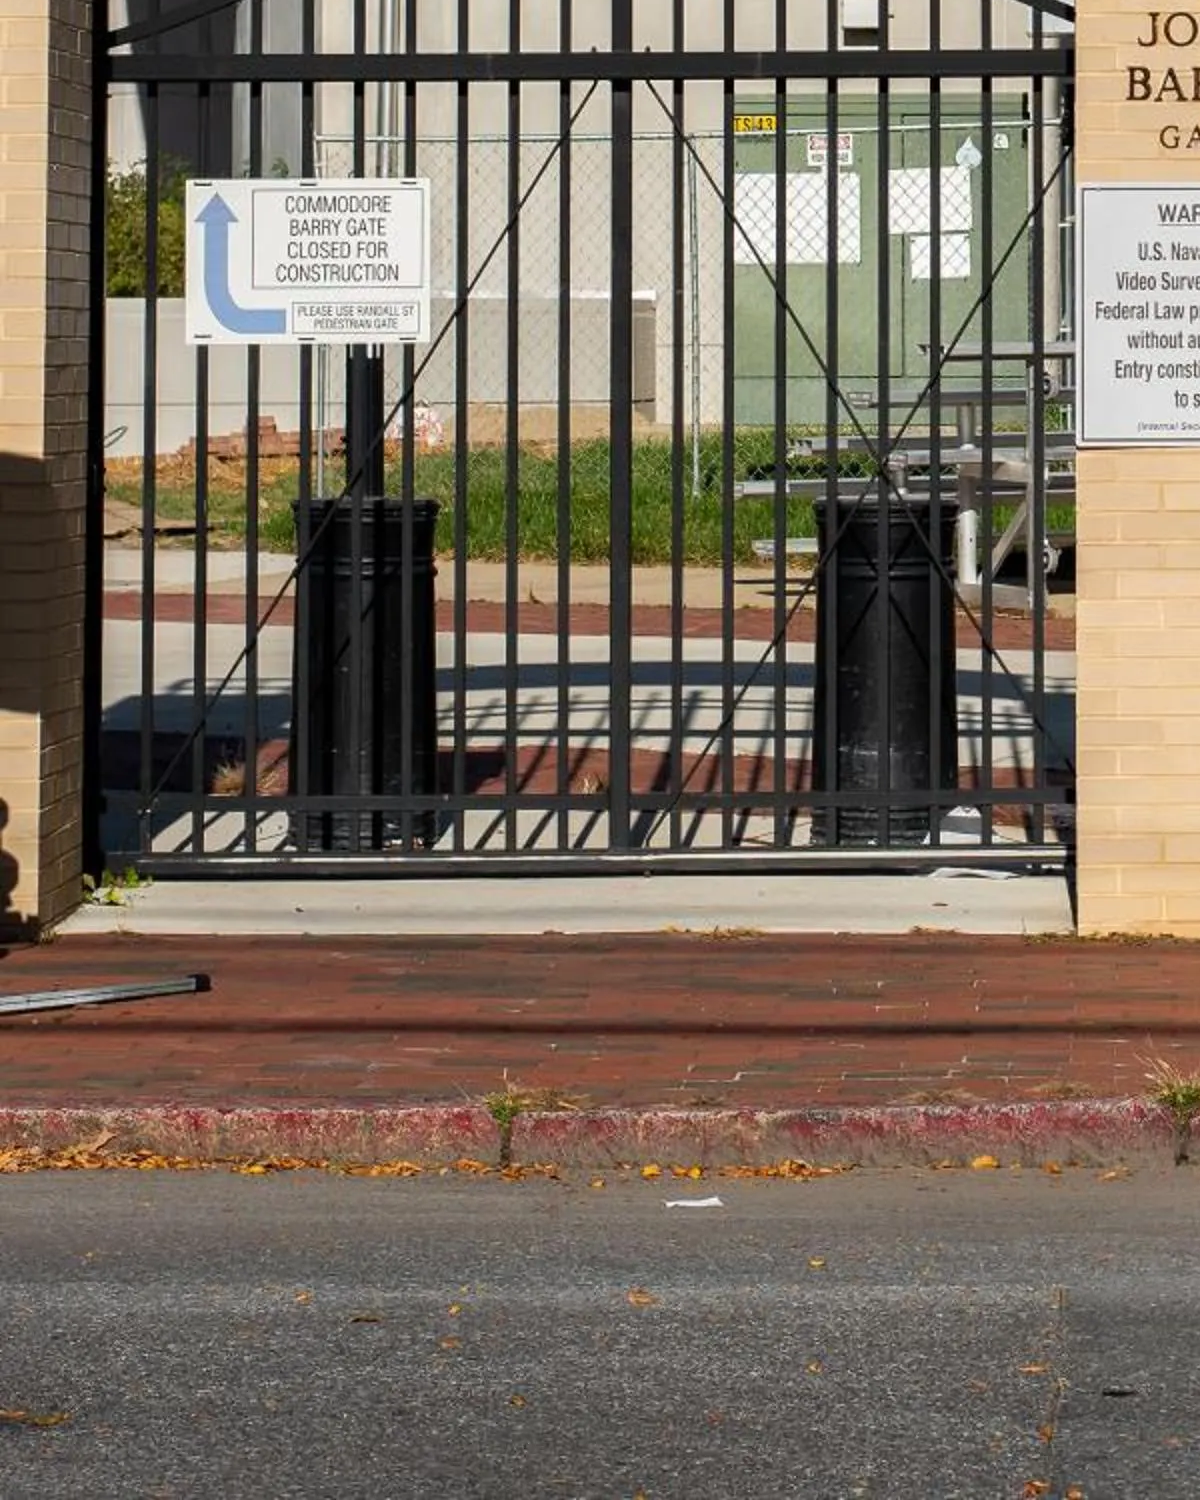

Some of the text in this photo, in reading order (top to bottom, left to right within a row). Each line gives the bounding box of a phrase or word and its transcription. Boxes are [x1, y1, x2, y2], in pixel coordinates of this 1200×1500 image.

[285, 196, 392, 213] COMMODORE
[289, 218, 386, 236] BARRY GATE
[287, 241, 388, 259] CLOSED FOR
[1138, 242, 1167, 261] U.S.
[275, 264, 399, 282] CONSTRUCTION
[1116, 271, 1157, 291] Video
[298, 306, 333, 317] PLEASE
[336, 306, 354, 317] USE
[358, 305, 400, 317] RANDALL
[1095, 301, 1149, 320] Federal
[1154, 301, 1184, 320] Law
[314, 318, 398, 329] PEDESTRIAN GATE
[1127, 331, 1184, 349] without
[1115, 359, 1152, 382] Entry
[1174, 390, 1189, 408] to
